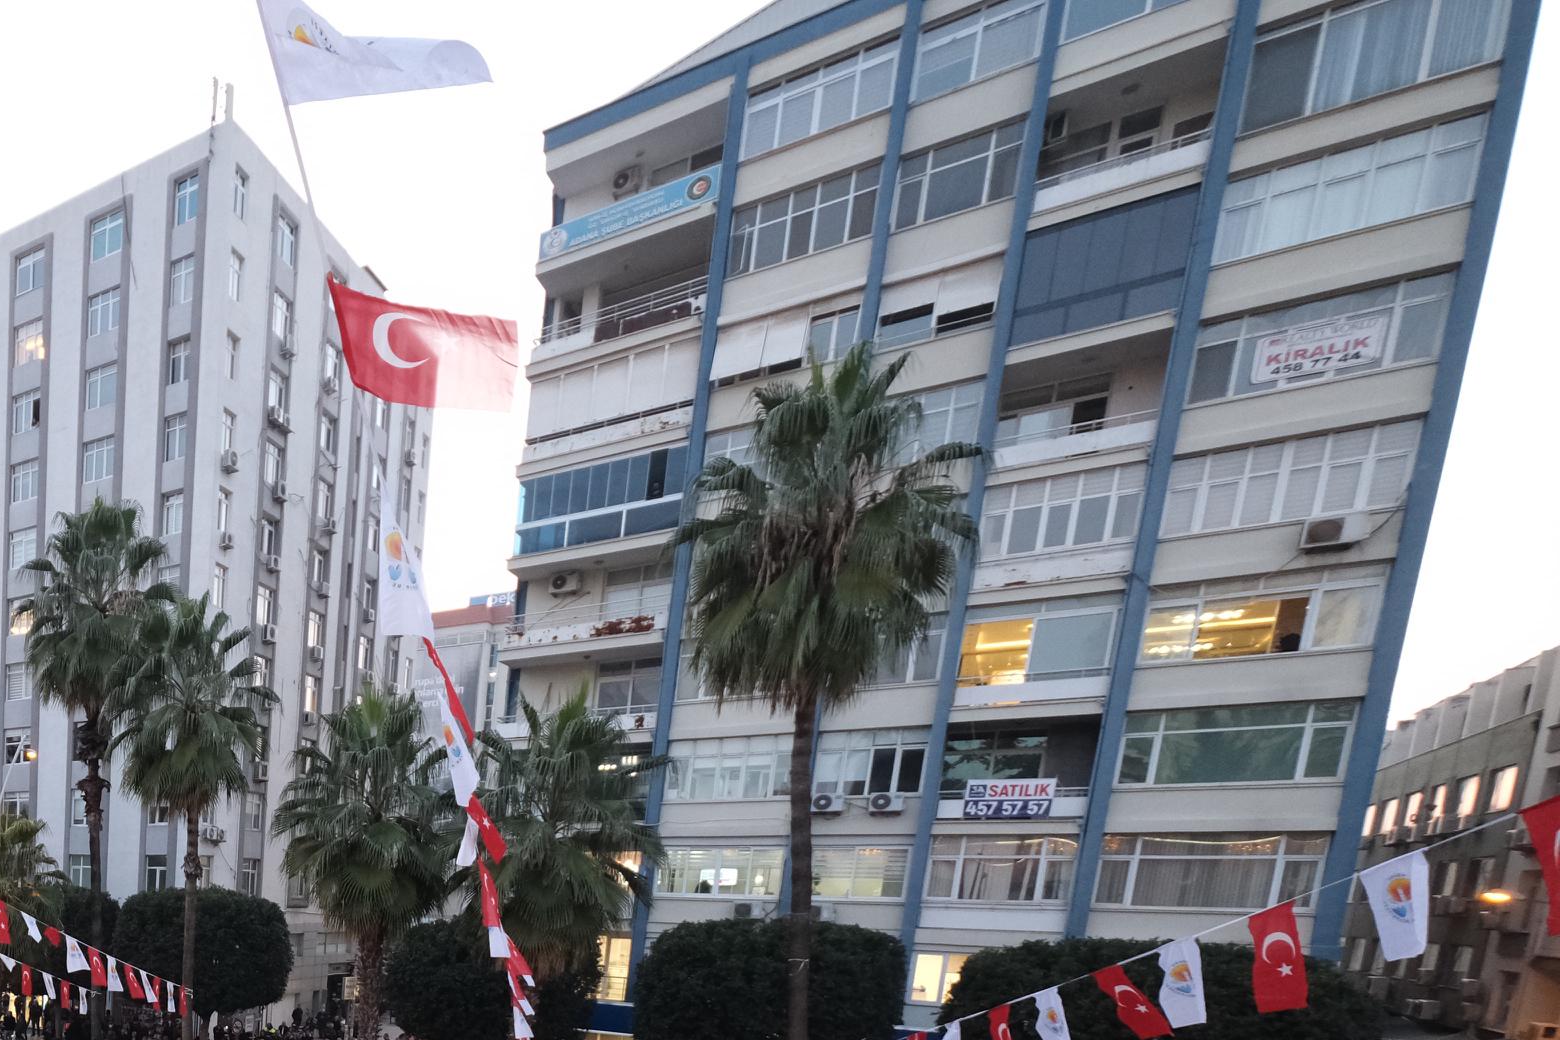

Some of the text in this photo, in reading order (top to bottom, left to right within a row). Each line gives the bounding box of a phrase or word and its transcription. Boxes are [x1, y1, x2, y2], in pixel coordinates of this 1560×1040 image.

[1270, 351, 1362, 376] 458 77 44
[988, 783, 1051, 797] SATILIK
[965, 801, 1049, 816] 457 57 57
